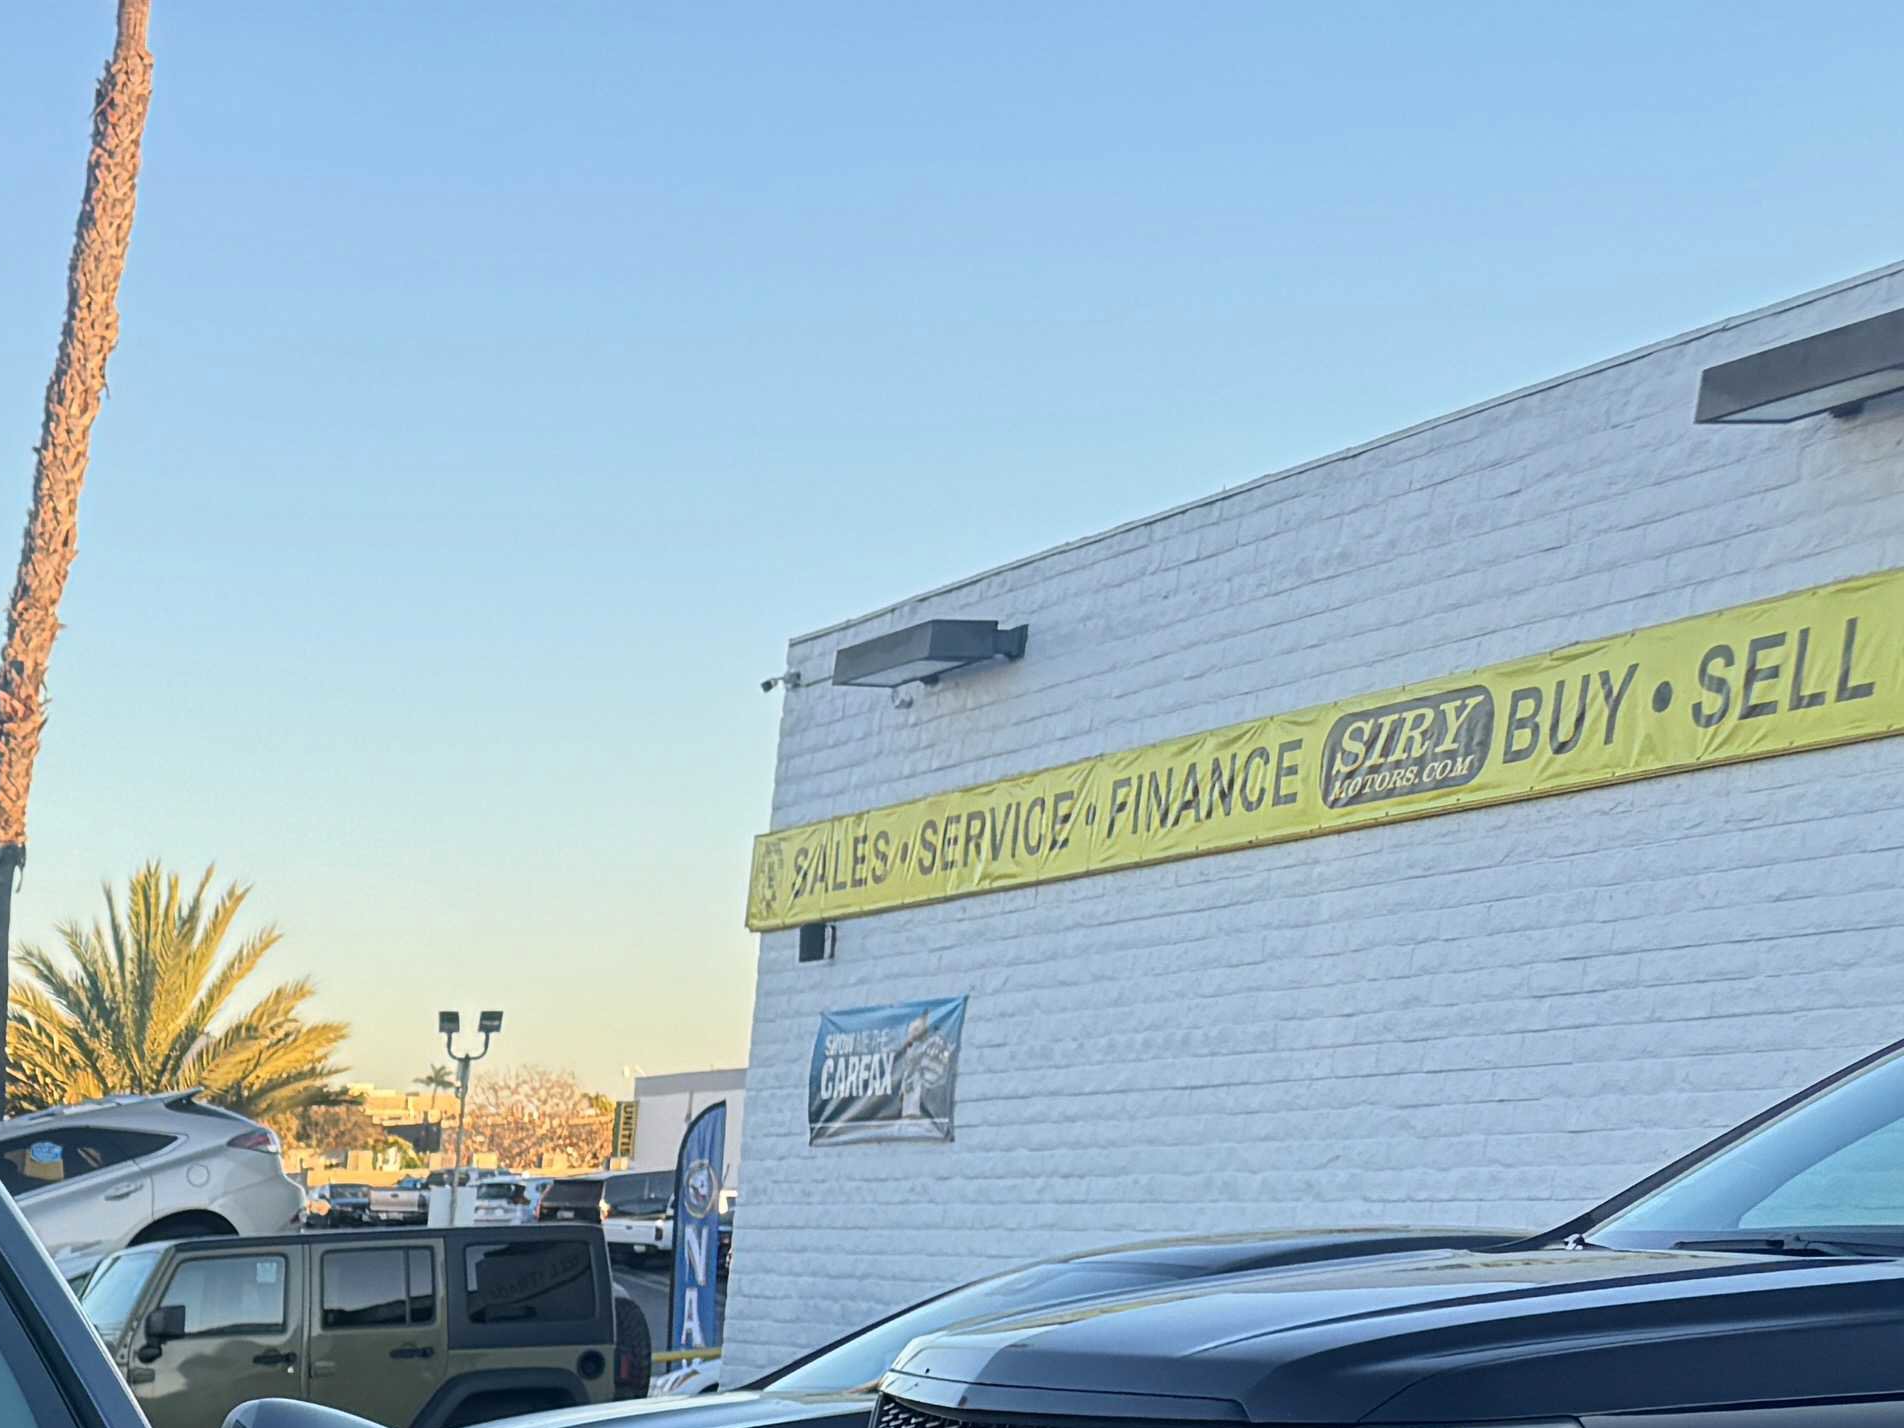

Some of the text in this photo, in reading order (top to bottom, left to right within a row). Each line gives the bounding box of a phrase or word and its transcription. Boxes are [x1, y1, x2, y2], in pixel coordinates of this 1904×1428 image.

[1502, 616, 1876, 764] BUY SELL
[1332, 694, 1485, 776] SIRY
[1328, 753, 1476, 802] MOTORS.COM
[792, 738, 1303, 902] SALES SERVICE FINANCE
[820, 1052, 896, 1100] CARFAX
